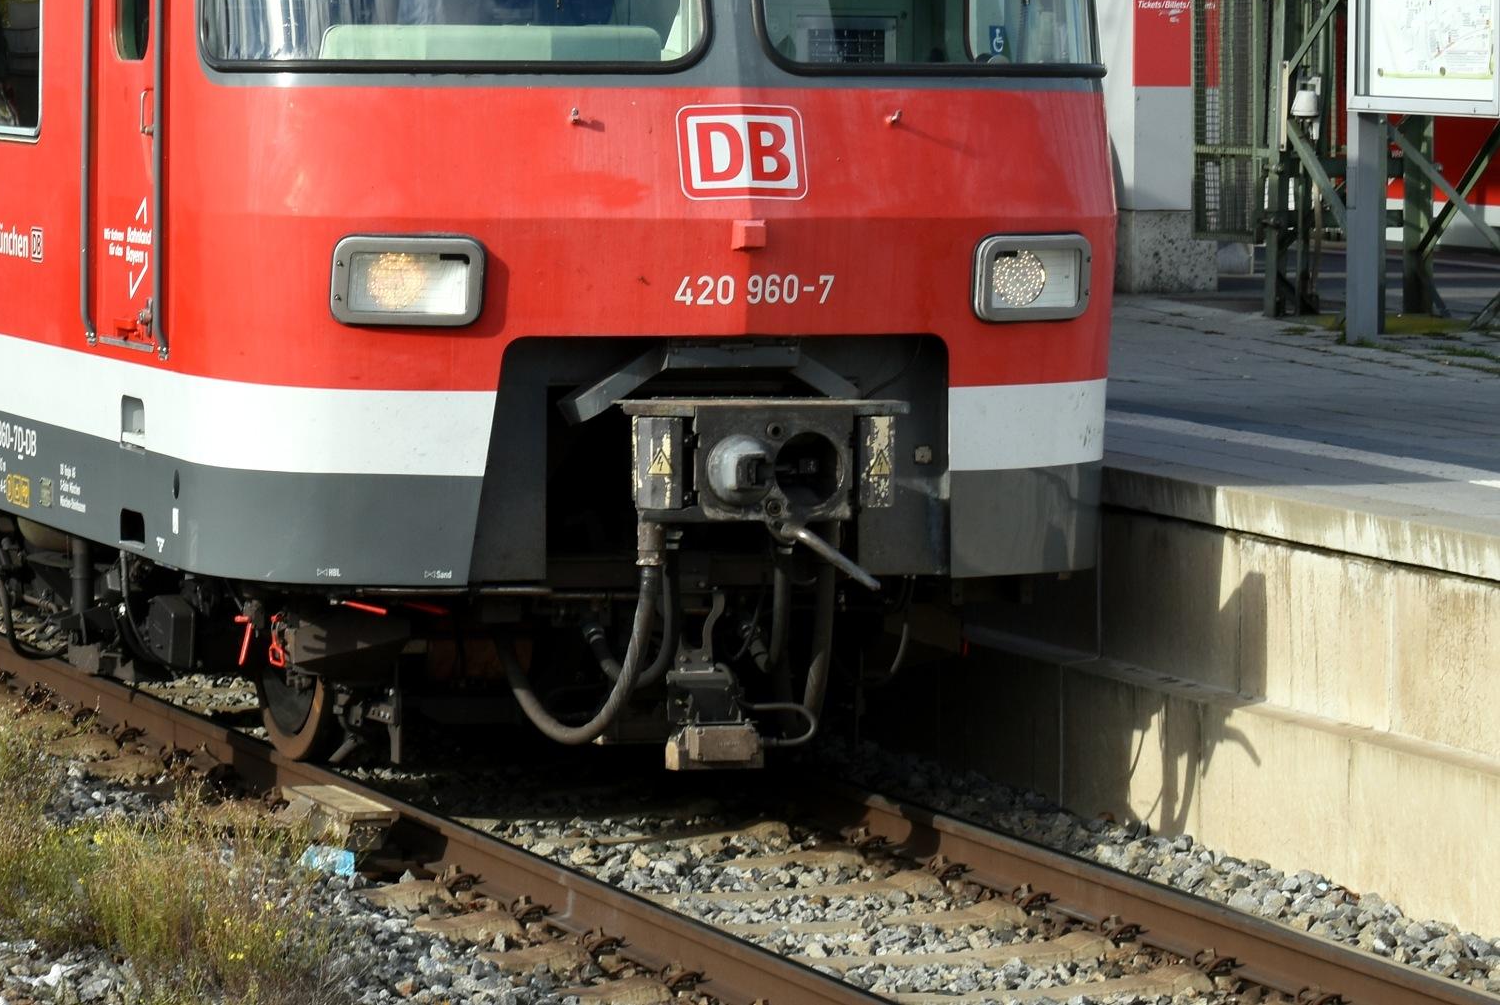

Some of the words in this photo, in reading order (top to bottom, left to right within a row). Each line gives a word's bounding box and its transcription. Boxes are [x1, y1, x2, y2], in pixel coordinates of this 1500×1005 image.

[690, 118, 794, 185] DB
[673, 275, 735, 306] 420
[746, 274, 836, 305] 960-7
